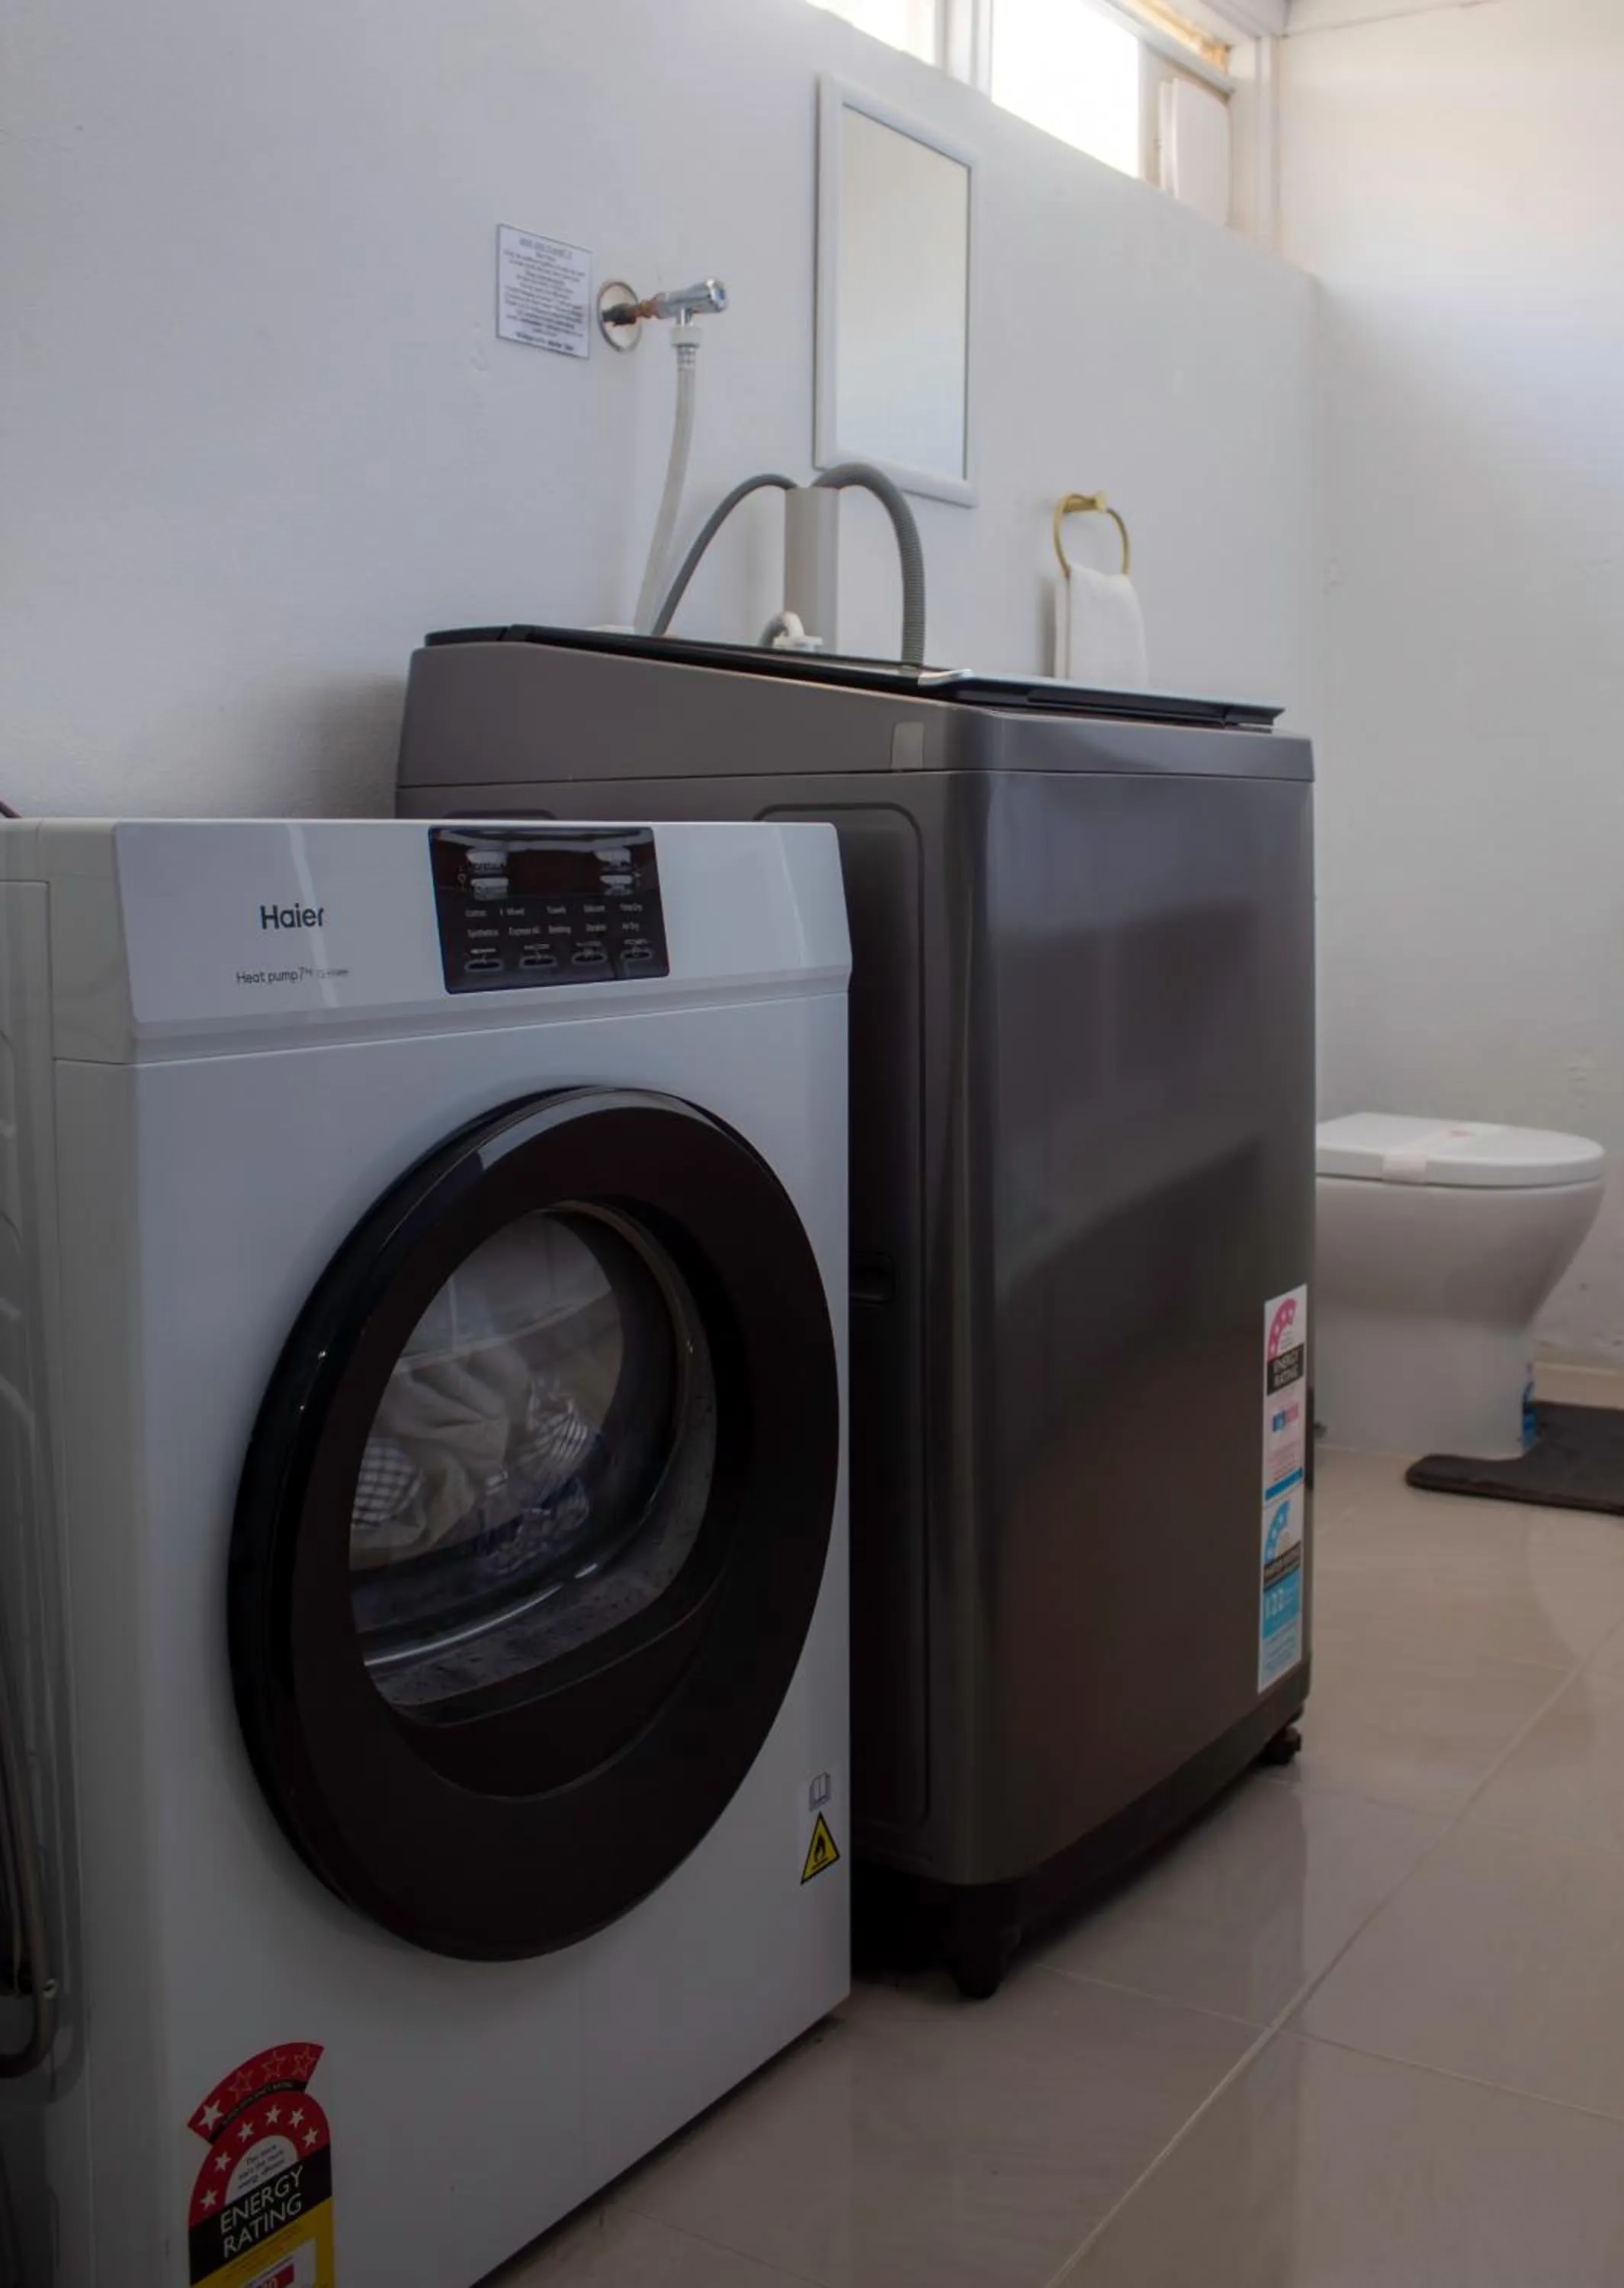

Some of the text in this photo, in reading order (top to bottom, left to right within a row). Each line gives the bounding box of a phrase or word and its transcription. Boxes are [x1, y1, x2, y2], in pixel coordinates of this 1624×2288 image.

[259, 903, 324, 930] Haier
[236, 970, 265, 984] Heat
[267, 969, 299, 984] pump
[220, 2163, 303, 2235] ENERGY
[223, 2192, 302, 2259] RATING
